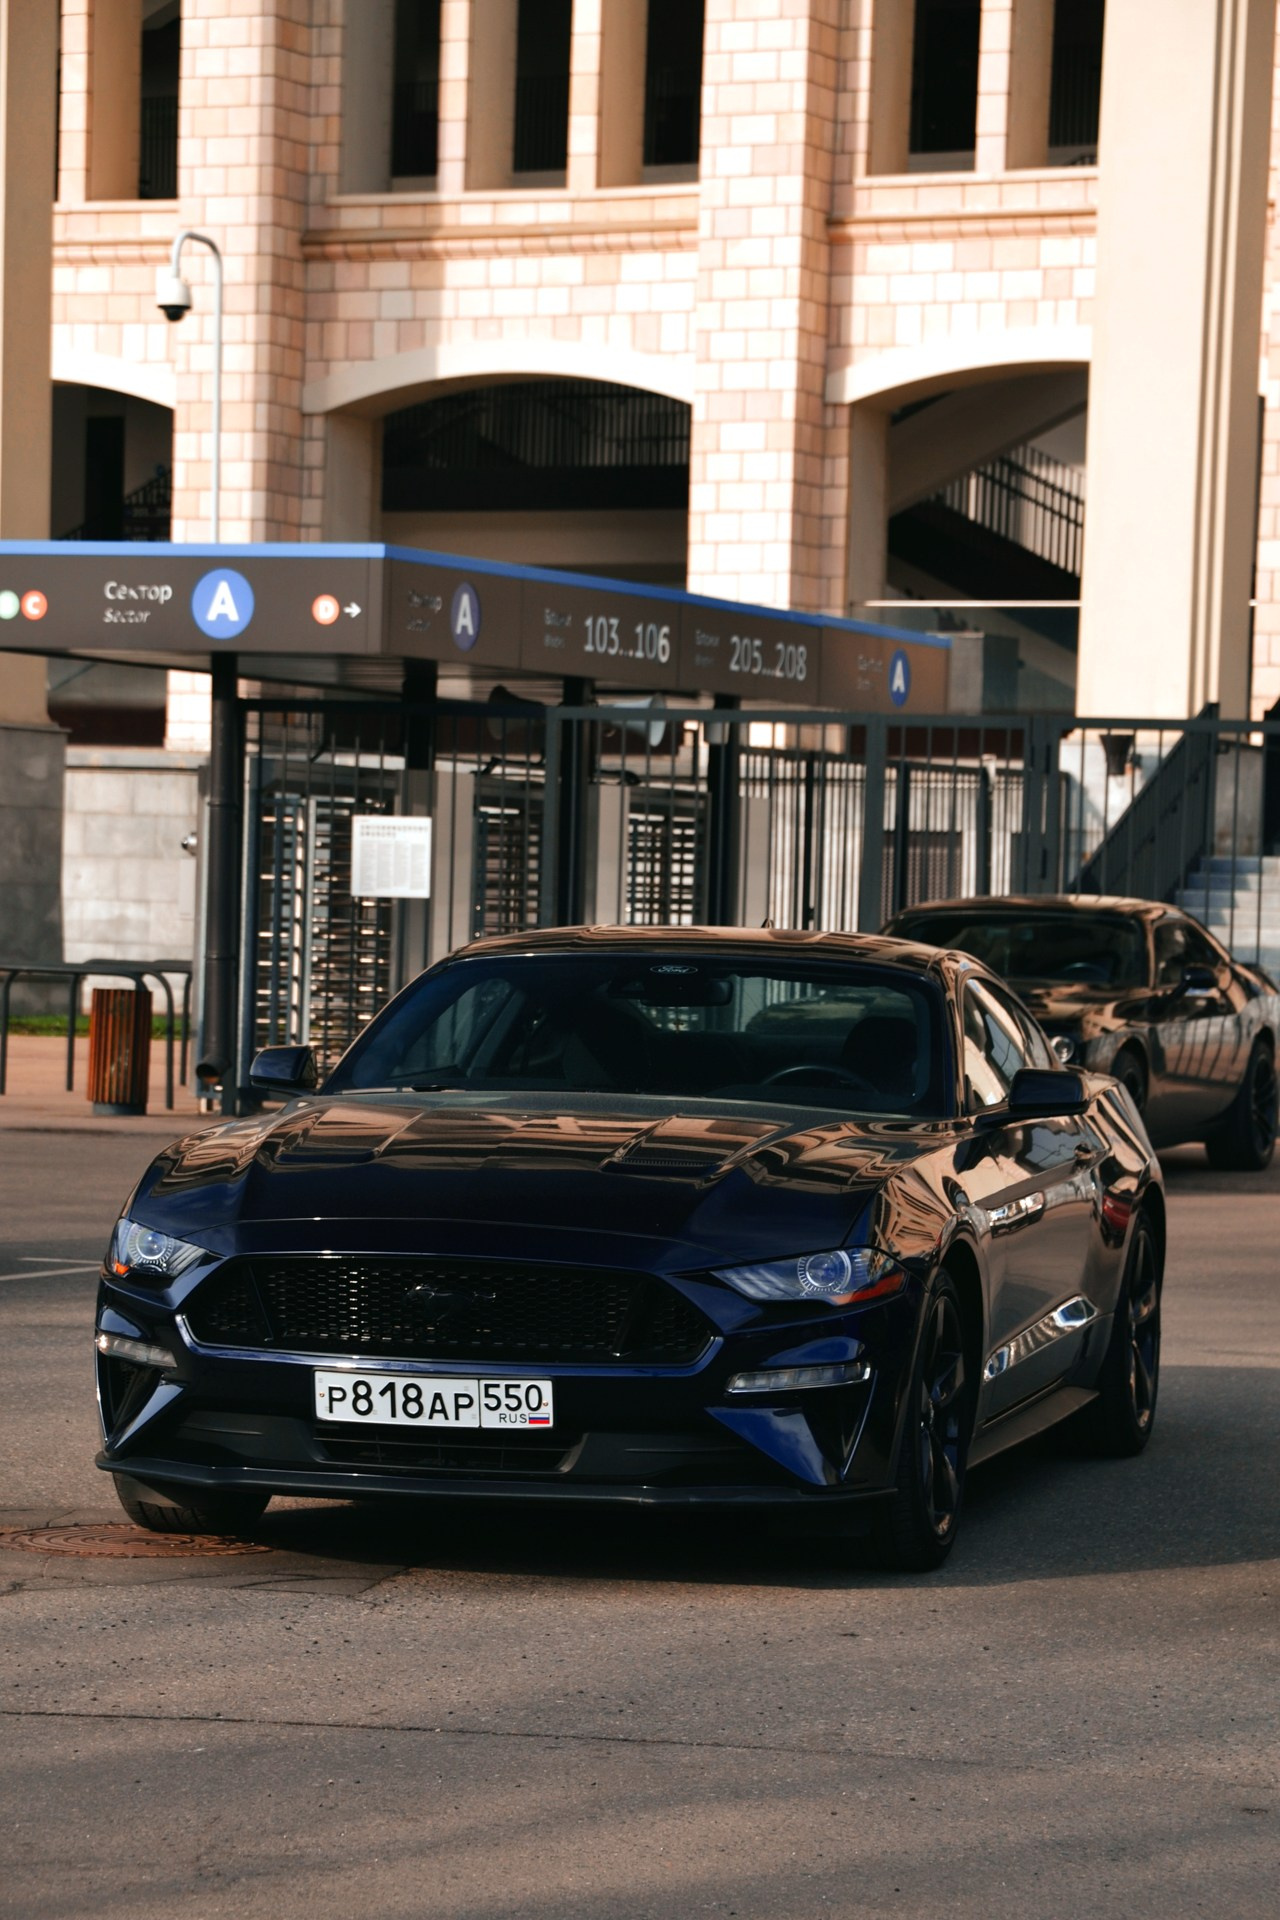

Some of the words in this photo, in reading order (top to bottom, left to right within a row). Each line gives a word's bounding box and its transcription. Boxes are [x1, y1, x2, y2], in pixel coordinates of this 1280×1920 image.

[103, 581, 173, 605] Сектор
[206, 580, 240, 622] A
[455, 592, 474, 636] A
[891, 659, 906, 694] A
[483, 1383, 543, 1412] 550
[498, 1413, 528, 1424] RUS
